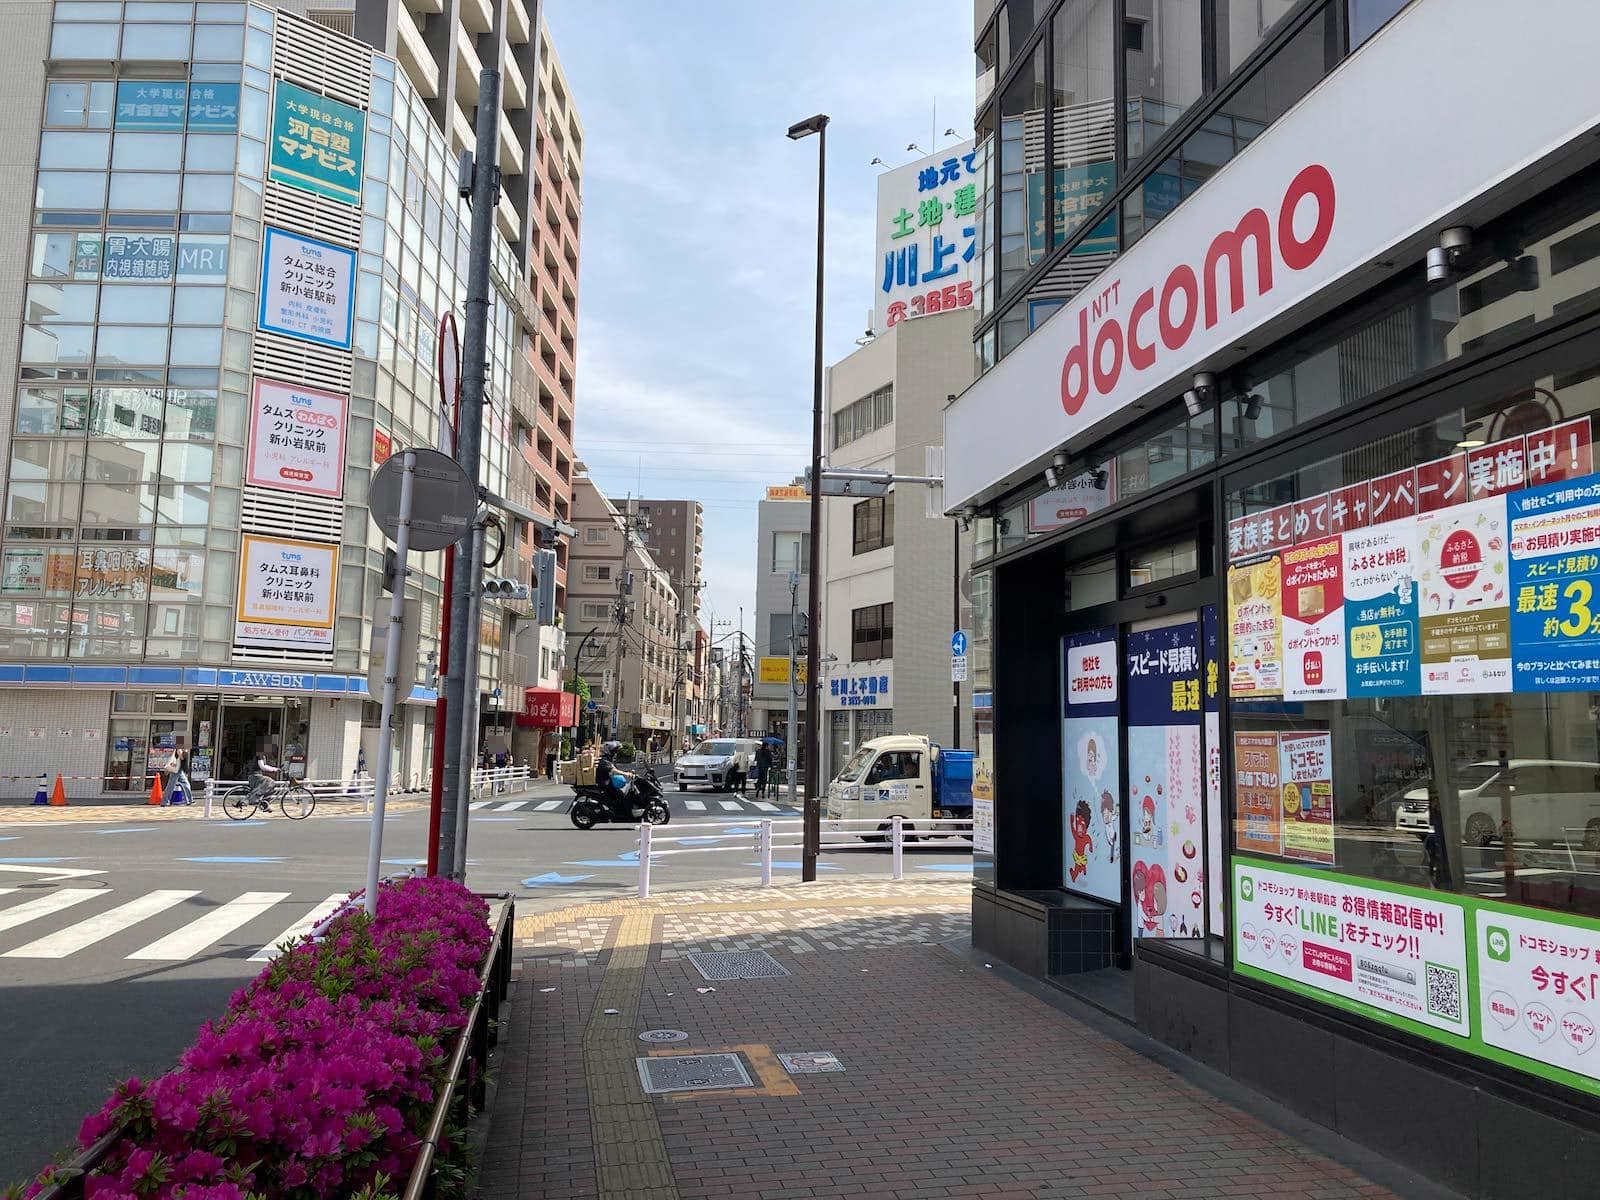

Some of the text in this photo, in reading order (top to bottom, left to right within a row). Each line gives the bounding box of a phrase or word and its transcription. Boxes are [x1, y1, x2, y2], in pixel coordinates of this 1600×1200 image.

[136, 87, 215, 100] 大学現役合格
[119, 103, 236, 118] 河合塾マナビス
[286, 100, 354, 132] 大学現役合格
[288, 117, 350, 154] 河合塾
[279, 135, 356, 176] マナビス
[108, 237, 172, 257] 胃・大腸
[301, 246, 322, 257] tums
[77, 258, 97, 270] 4F
[105, 258, 170, 278] 内視鏡随時
[180, 249, 224, 270] MRI
[284, 255, 336, 278] タムス総合
[284, 270, 334, 290] クリニック
[280, 281, 336, 305] 新小岩駅前
[911, 280, 973, 317] 3655
[1061, 164, 1336, 416] docomo
[1092, 279, 1121, 323] NTT
[291, 395, 312, 406] tums
[262, 404, 294, 419] タムス
[274, 420, 325, 438] クリニック
[269, 433, 326, 453] 新小岩駅前
[1447, 539, 1474, 553] ふるさと
[81, 549, 150, 572] 耳鼻咽喉科
[281, 551, 301, 561] tums
[1453, 552, 1468, 564] 納税
[260, 562, 320, 578] タムス耳鼻科
[1527, 554, 1599, 577] スピード見積り
[76, 577, 146, 598] アレルギー科
[266, 576, 313, 590] クリニック
[262, 588, 314, 603] 新小岩駅前
[1516, 582, 1559, 613] 最速
[1082, 656, 1100, 672] 他社を
[1130, 647, 1199, 676] スピード見積り
[1356, 659, 1409, 674] お手伝いします!
[231, 672, 304, 689] LAWSON
[1071, 676, 1113, 693] ご利用中の方も
[1171, 679, 1200, 711] 最速
[1245, 751, 1269, 768] スマホ
[1290, 750, 1324, 770] ドコモに
[1291, 767, 1323, 781] しませんか?
[1257, 881, 1443, 936] ドコモショップ 新小岩駅前店 お得情報配信中!
[1261, 935, 1275, 945] イベント
[1492, 937, 1505, 948] LINE
[1519, 934, 1590, 961] ドコモショップ
[1491, 1002, 1515, 1016] 商品情報
[1526, 1010, 1553, 1025] イベント
[1533, 1021, 1545, 1032] 情報
[1562, 1020, 1594, 1036] キャンペーン
[1571, 1033, 1584, 1043] 情報
